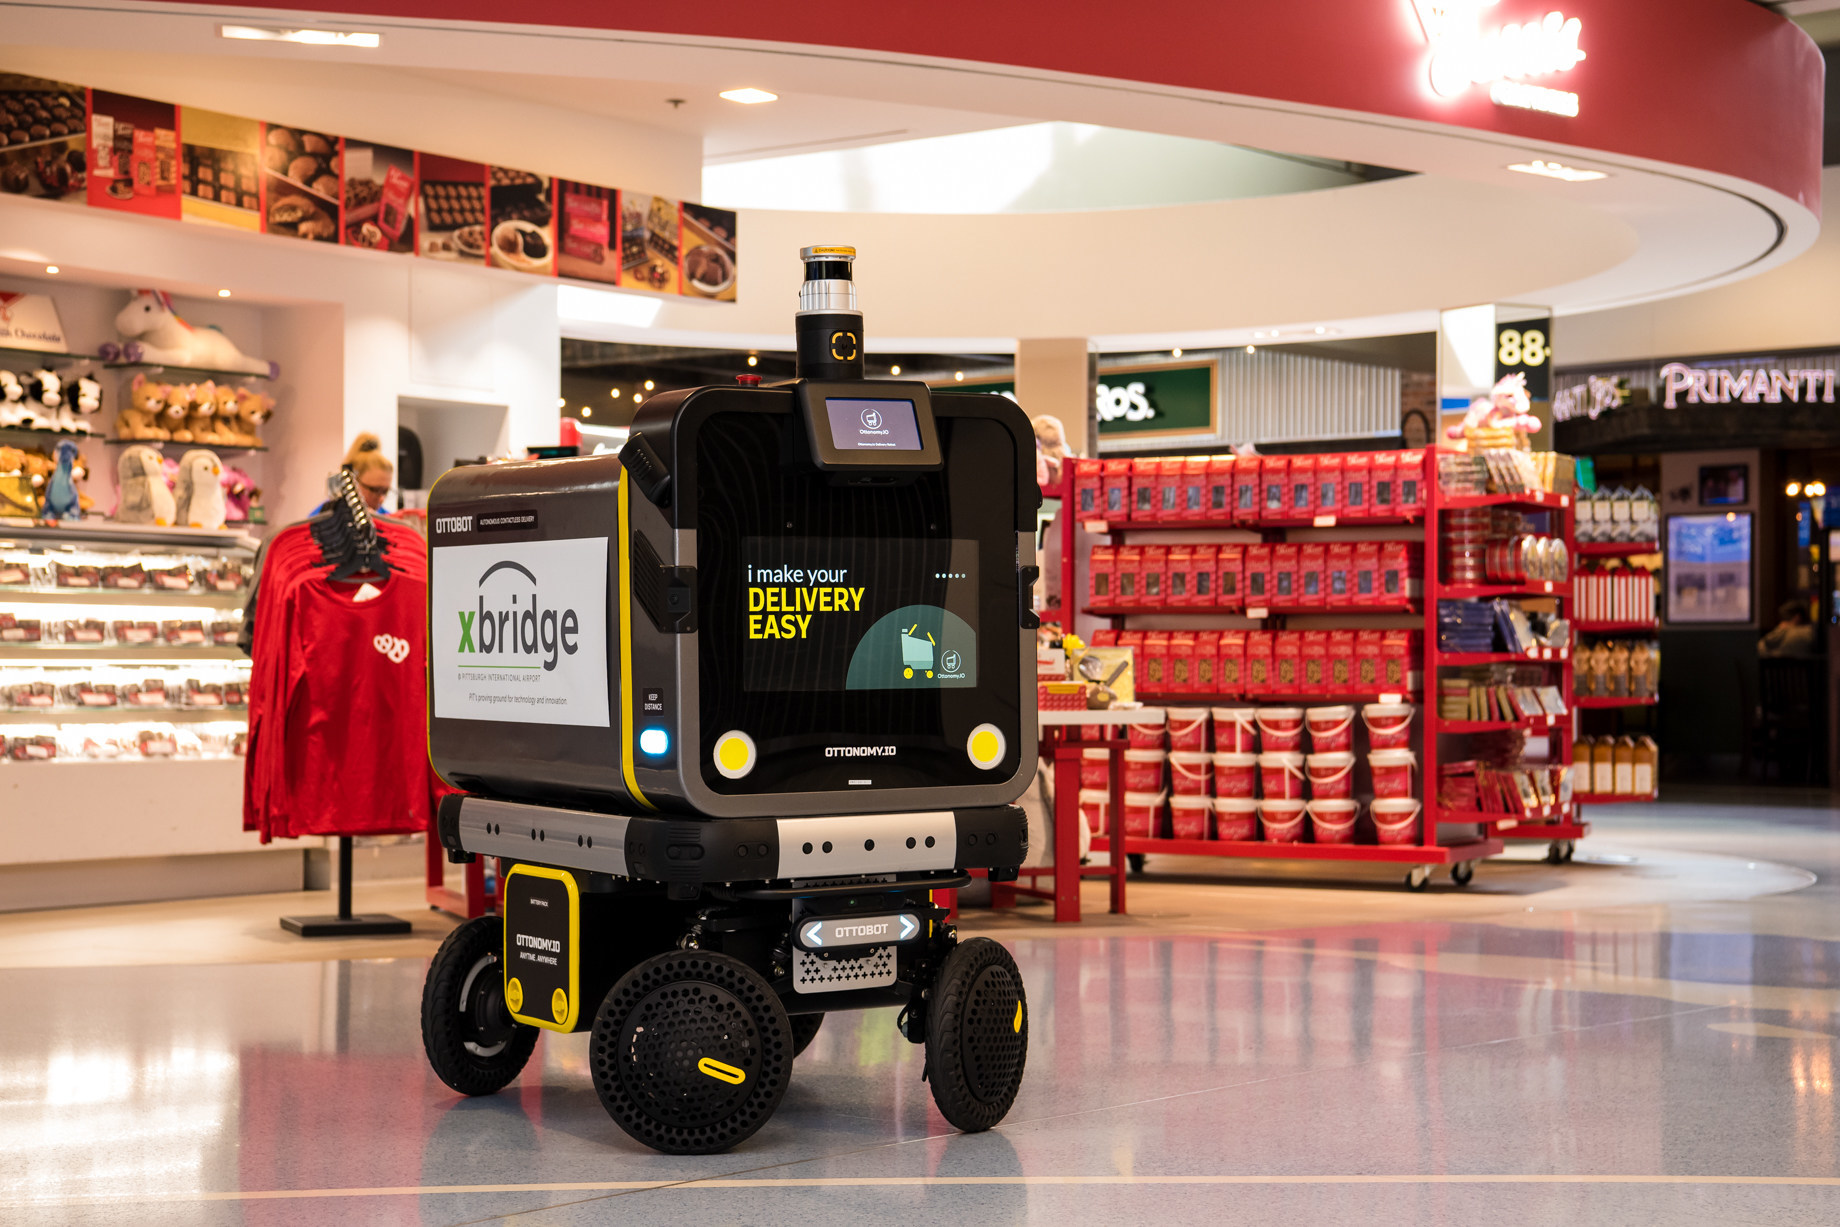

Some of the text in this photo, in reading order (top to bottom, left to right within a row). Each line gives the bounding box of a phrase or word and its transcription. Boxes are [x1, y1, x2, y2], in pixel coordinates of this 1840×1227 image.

[1660, 362, 1835, 409] PRIMANTI
[436, 516, 473, 533] OTTOBOT
[748, 564, 848, 586] i make your
[748, 587, 865, 612] DELIVERY
[458, 594, 579, 671] xbridge
[749, 614, 812, 639] EASY
[488, 673, 521, 681] INTERNATIONAL
[522, 674, 541, 682] AIRPORT
[478, 695, 493, 704] proving
[492, 695, 507, 704] ground
[513, 695, 536, 705] technology
[536, 696, 545, 704] and
[825, 745, 897, 757] OTTONOMY.IO
[835, 923, 889, 938] OTTOBOT
[516, 933, 560, 953] OTTONOMY.IO
[537, 955, 557, 966] ANYWHERE
